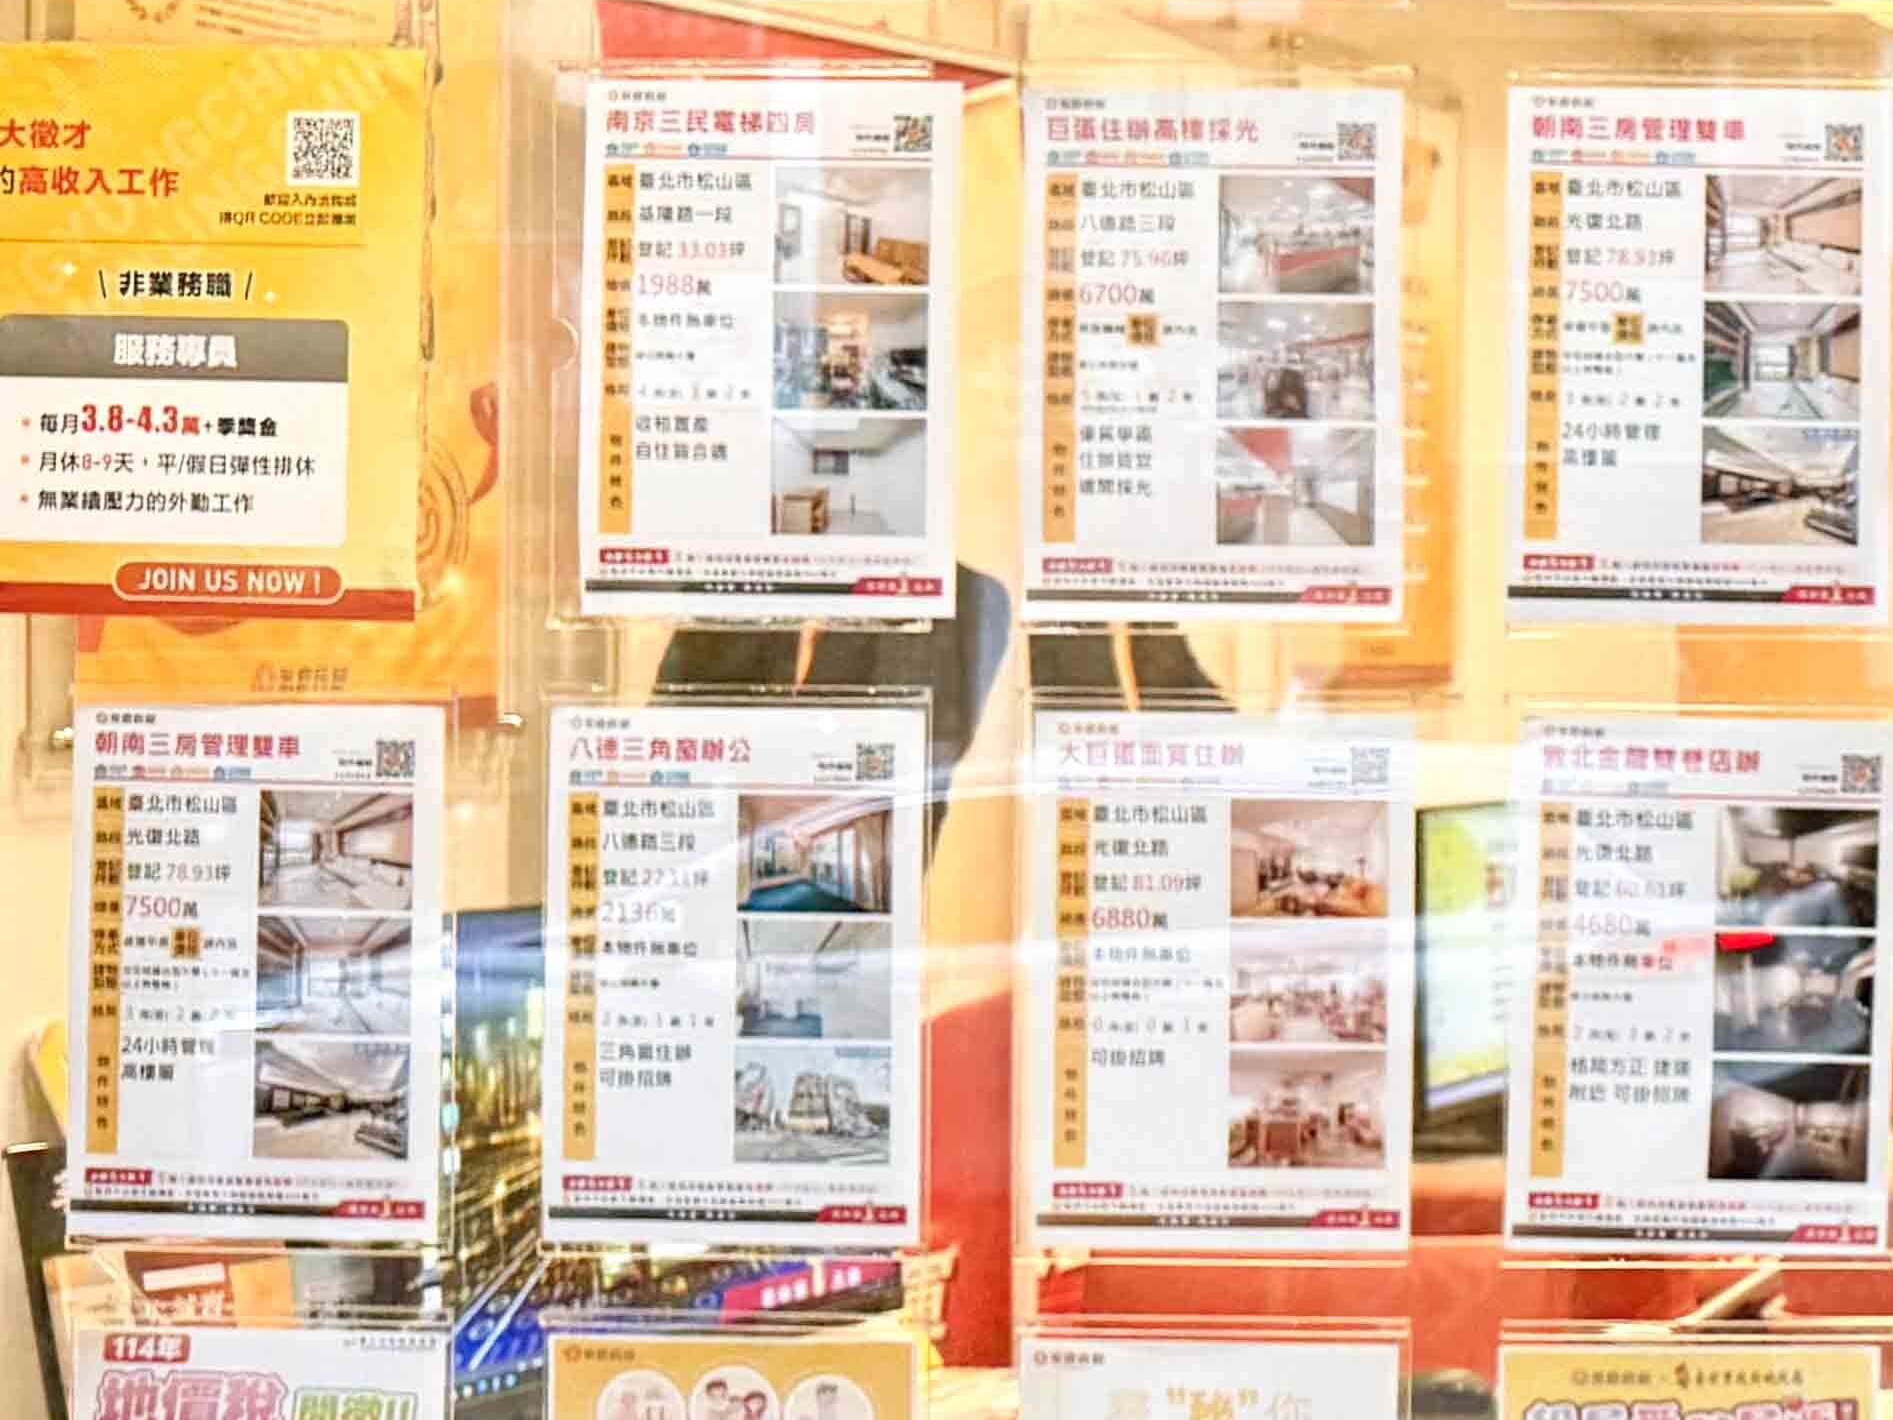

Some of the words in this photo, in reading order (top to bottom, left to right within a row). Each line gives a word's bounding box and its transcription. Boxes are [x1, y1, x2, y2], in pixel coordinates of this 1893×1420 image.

[0, 119, 92, 149] 大徵才
[119, 270, 232, 298] 非業務職
[638, 274, 712, 296] 1988萬
[1080, 284, 1155, 305] 6700萬
[1567, 281, 1641, 303] 7500萬
[114, 333, 237, 368] 服務專員
[38, 491, 254, 514] 無業績壓力的外勤工作
[138, 569, 195, 591] JOIN
[205, 570, 238, 592] US
[248, 571, 306, 594] NOW
[96, 733, 300, 758] 朝南三房管理雙車
[570, 738, 751, 763] 八德三角窗辦公
[603, 833, 695, 852] 八德路三段
[126, 895, 199, 917] 7500萬
[1092, 906, 1168, 929] 6880萬
